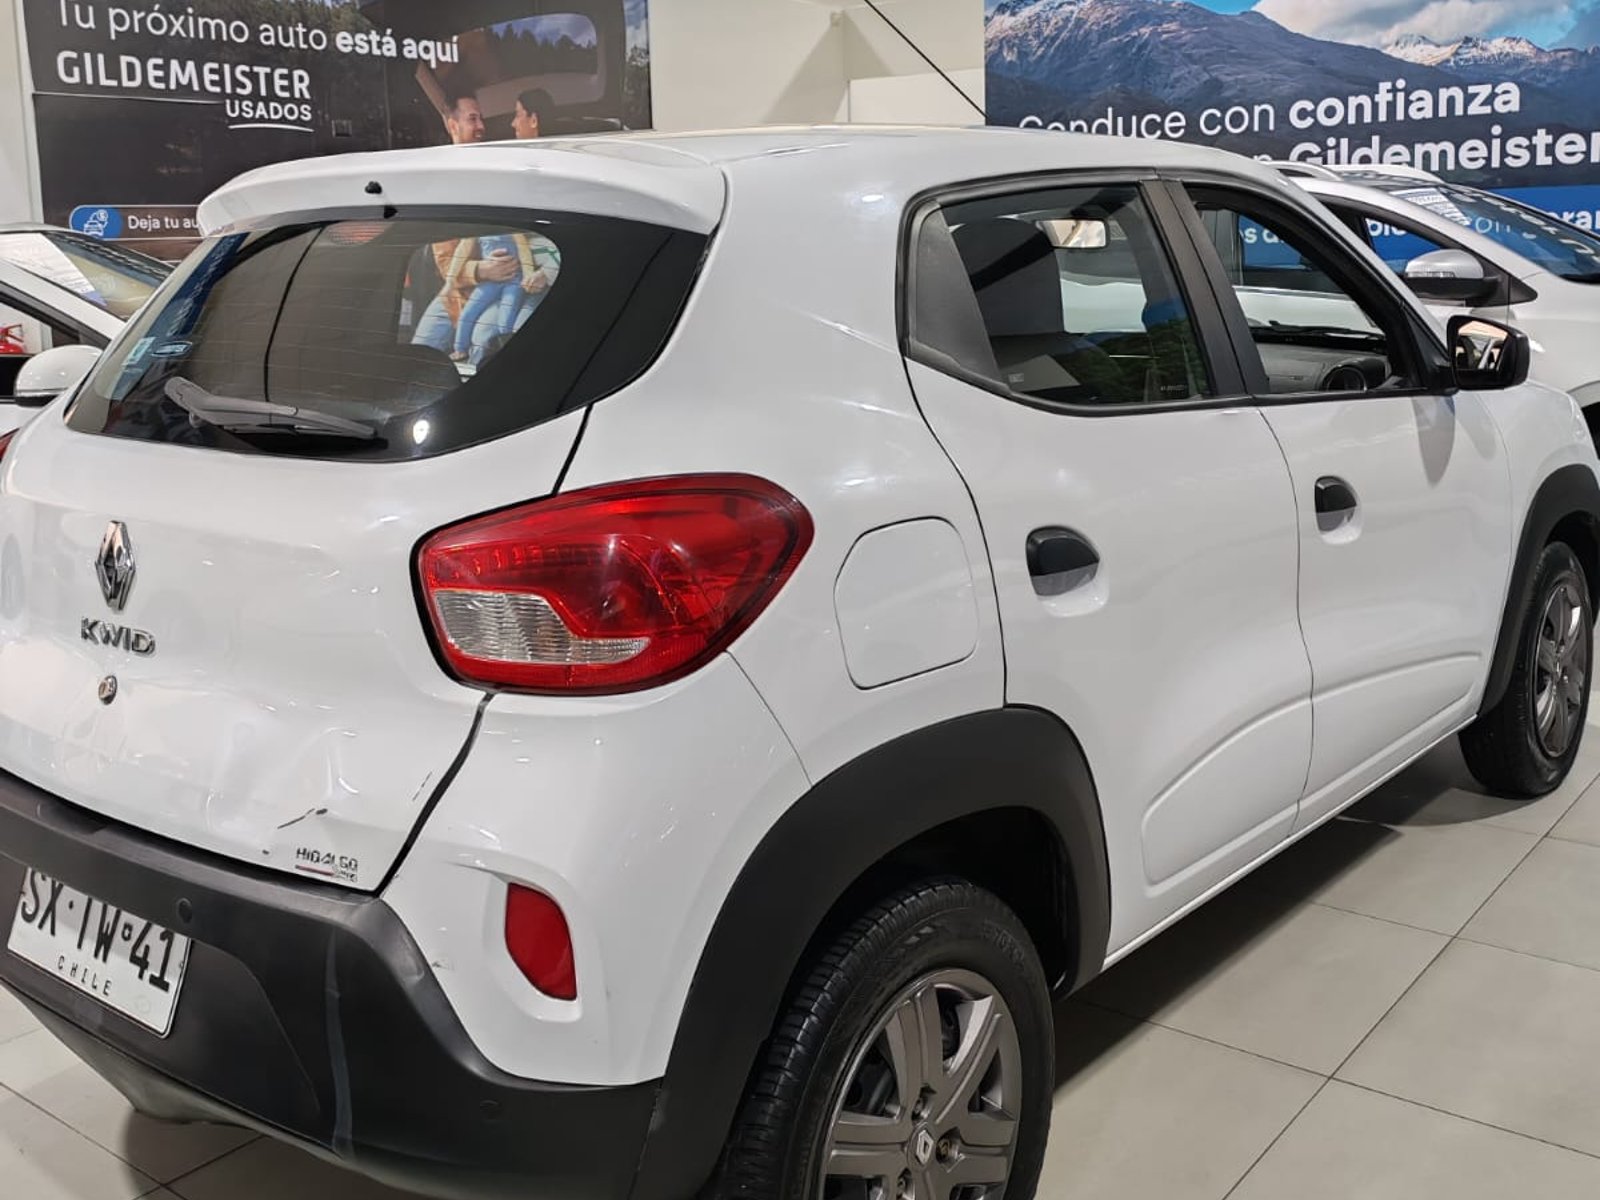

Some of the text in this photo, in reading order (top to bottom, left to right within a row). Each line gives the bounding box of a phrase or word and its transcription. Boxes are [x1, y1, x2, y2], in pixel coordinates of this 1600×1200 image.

[108, 3, 250, 43] próximo
[258, 22, 327, 50] auto
[335, 28, 397, 57] está
[402, 35, 459, 69] aquí
[56, 50, 311, 99] GILDEMEISTER
[225, 99, 313, 121] USADOS
[1199, 103, 1275, 136] con
[1288, 78, 1521, 129] confianza
[127, 214, 161, 232] Deja
[164, 214, 179, 229] tu
[81, 617, 156, 656] KWID
[57, 954, 112, 996] CHILE
